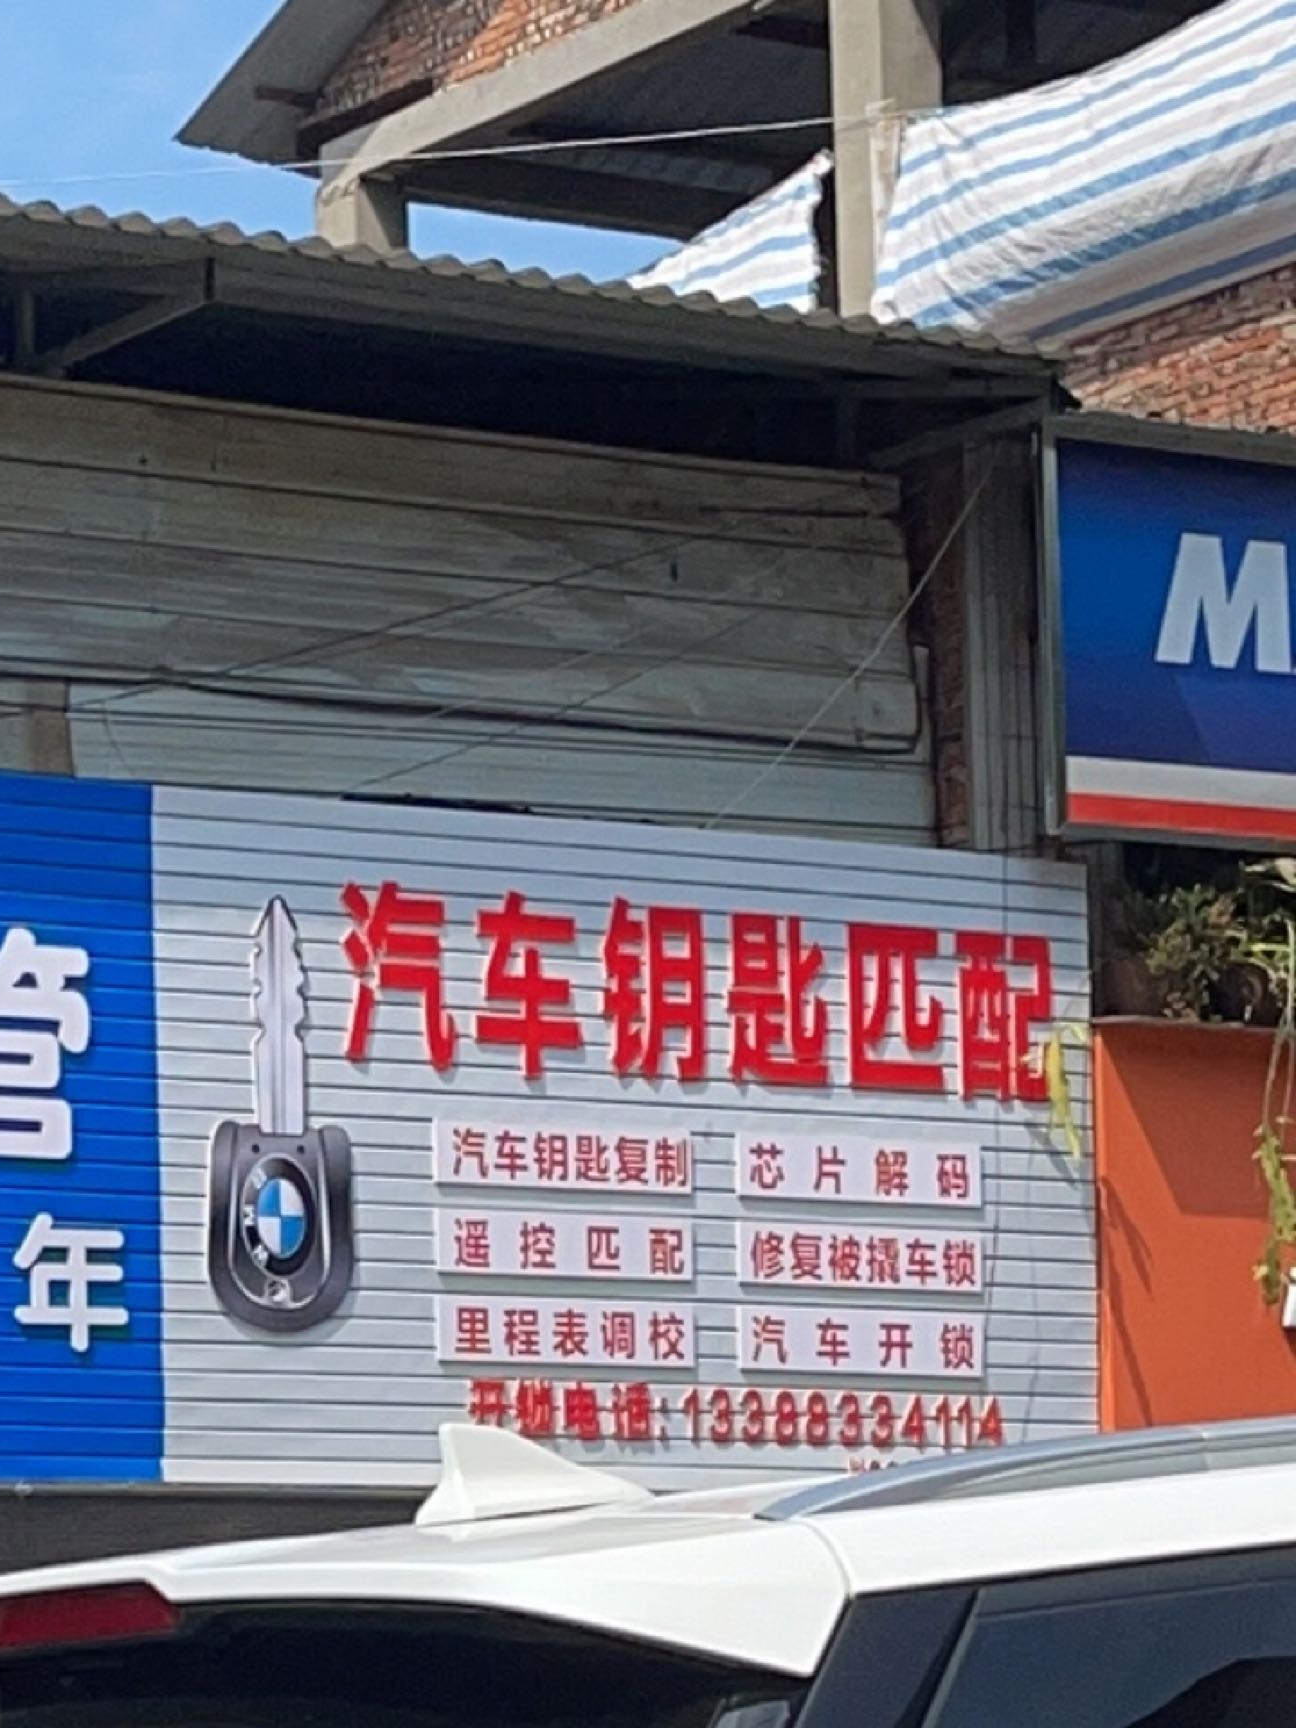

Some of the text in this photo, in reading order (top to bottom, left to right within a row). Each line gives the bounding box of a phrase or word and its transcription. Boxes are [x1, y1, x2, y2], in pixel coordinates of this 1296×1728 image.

[1156, 532, 1296, 675] M
[340, 880, 1052, 1102] 汽车钥匙匹配
[452, 1127, 689, 1187] 汽车钥匙复制
[748, 1142, 970, 1199] 芯片解码
[454, 1217, 686, 1275] 遥控匹配
[454, 1307, 686, 1360] 里程表调校
[752, 1315, 975, 1370] 汽车开锁
